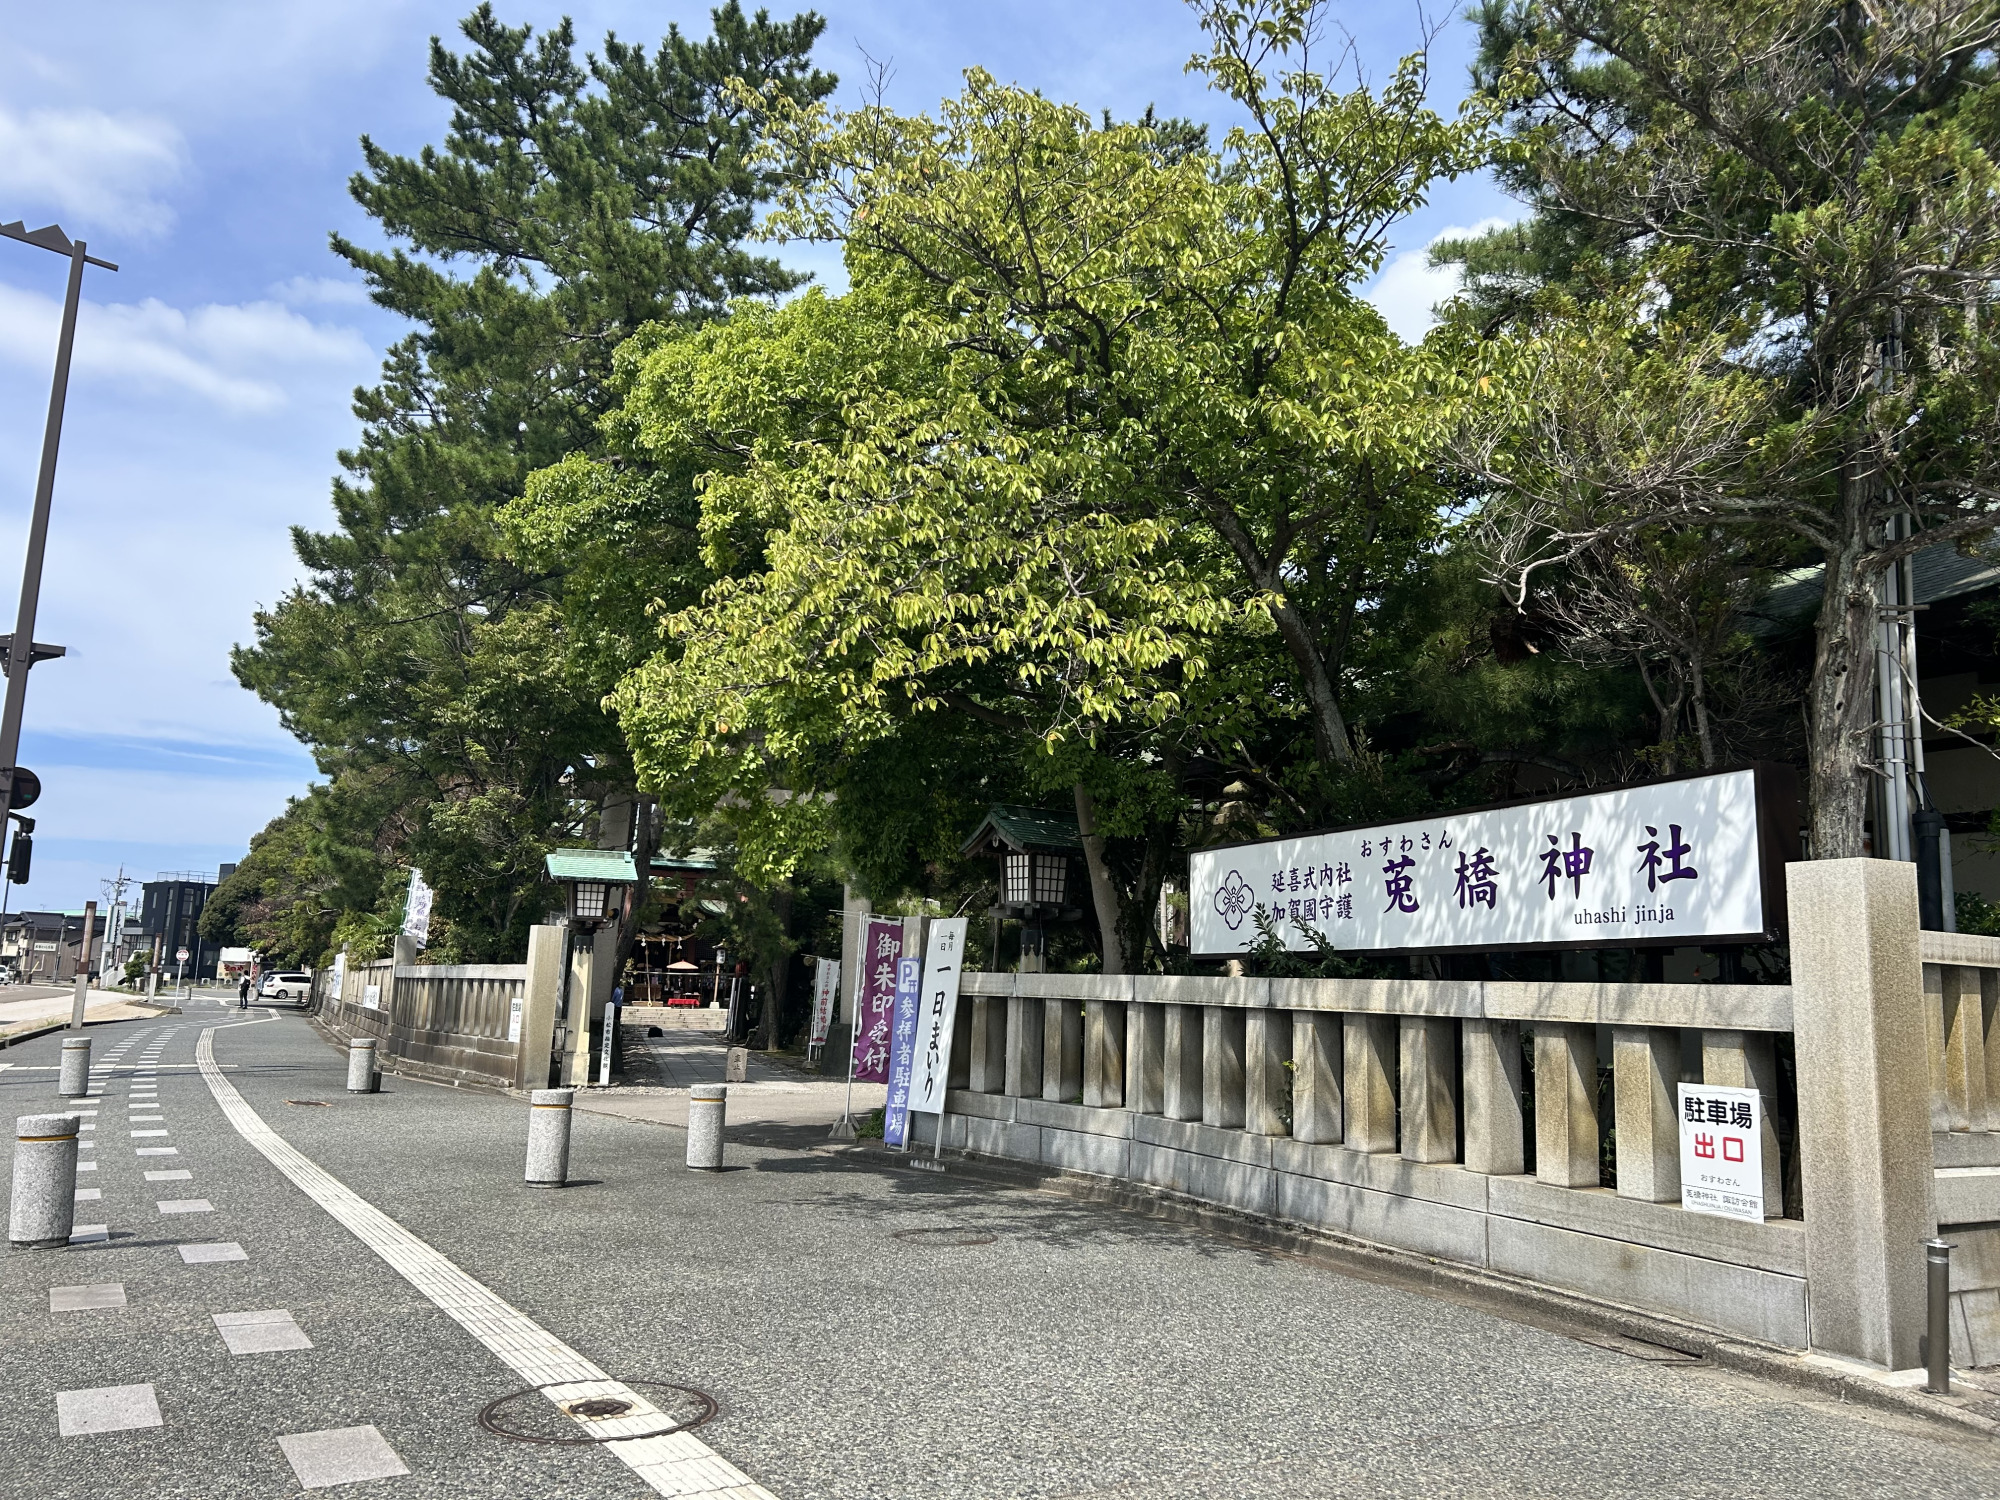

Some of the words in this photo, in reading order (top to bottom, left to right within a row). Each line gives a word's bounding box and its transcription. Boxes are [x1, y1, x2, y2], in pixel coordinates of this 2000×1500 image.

[1360, 829, 1453, 858] おすわさん
[1271, 861, 1353, 893] 延喜式内社
[1382, 823, 1699, 914] 菟橋神社
[1271, 893, 1354, 923] 加賀國守護
[1573, 906, 1627, 926] uhashi
[1634, 902, 1675, 925] jinja
[862, 932, 900, 1075] 御朱印受付
[924, 965, 952, 1104] 一日まいり
[889, 996, 915, 1138] 参拝者駐車場
[1684, 1097, 1752, 1130] 駐車場
[1694, 1132, 1744, 1163] 出口
[1700, 1174, 1741, 1187] おすわさん
